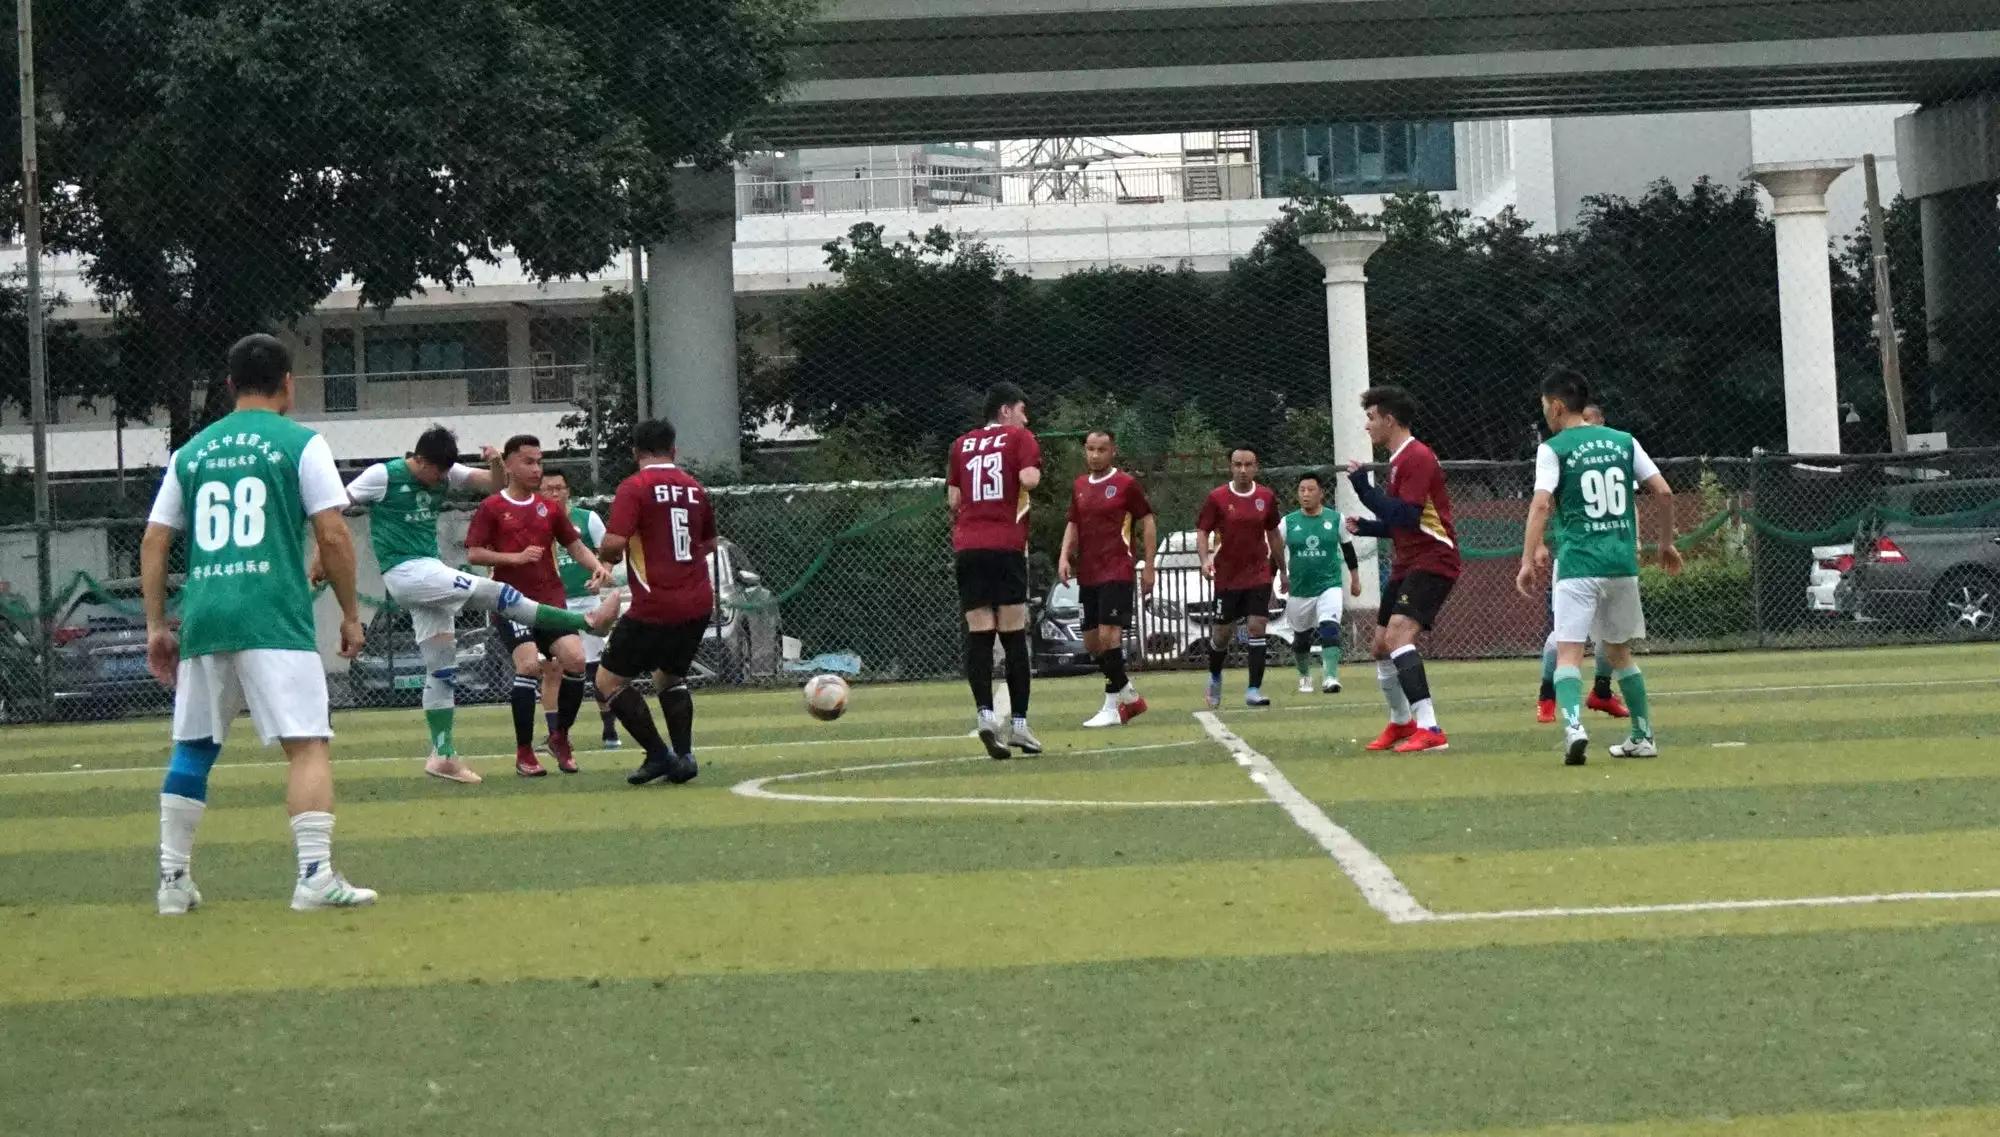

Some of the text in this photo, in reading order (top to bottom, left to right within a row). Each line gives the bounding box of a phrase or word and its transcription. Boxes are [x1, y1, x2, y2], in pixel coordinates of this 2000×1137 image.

[962, 432, 1008, 452] SFC
[654, 484, 700, 504] SFC
[965, 451, 1004, 501] 13
[1580, 466, 1627, 519] 96
[195, 476, 267, 551] 68
[670, 507, 692, 562] 6
[453, 575, 472, 591] 12
